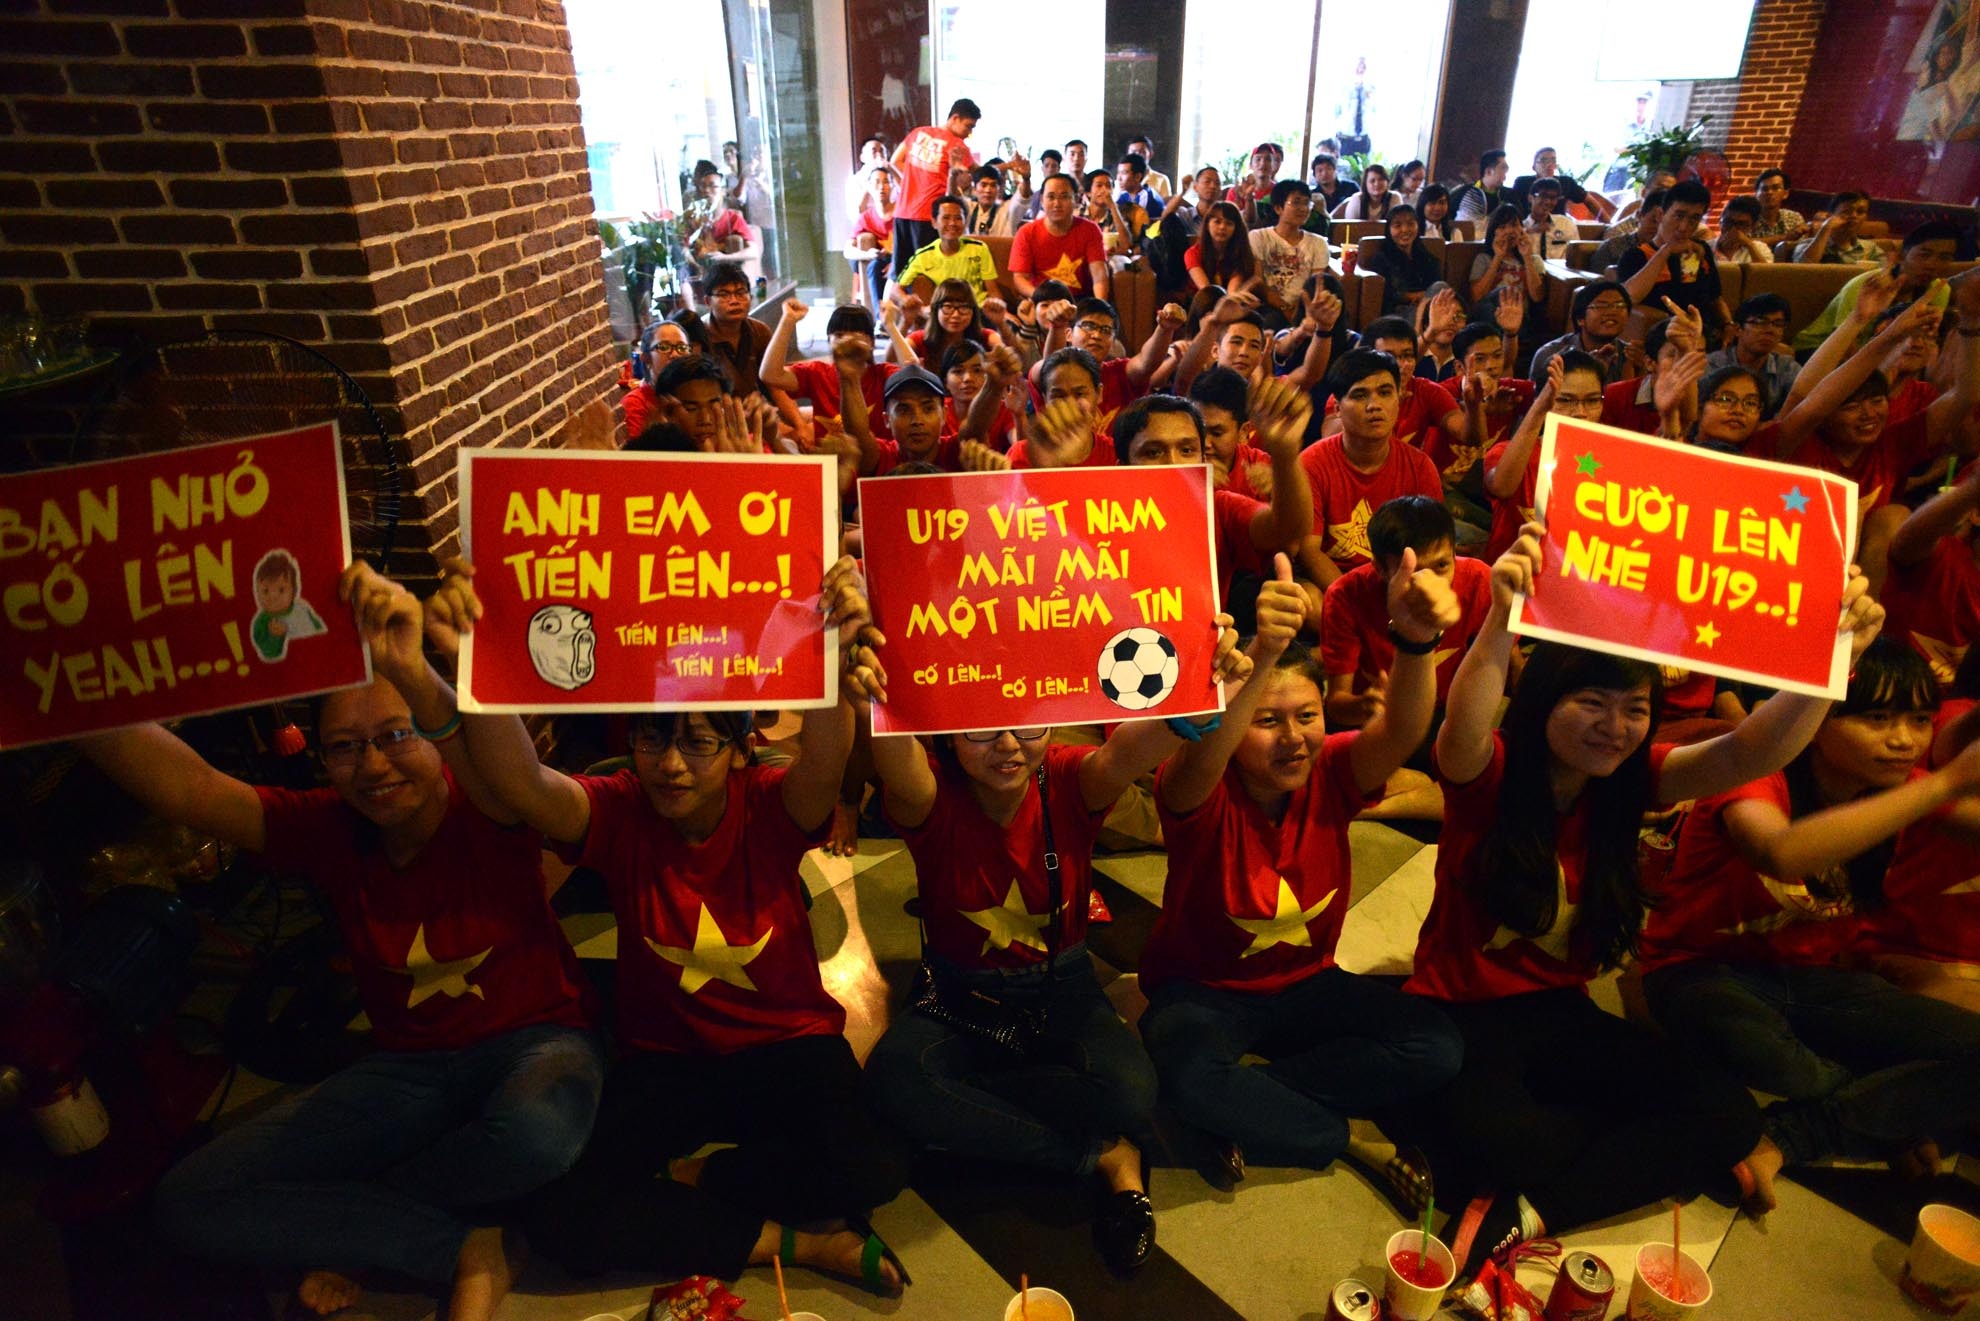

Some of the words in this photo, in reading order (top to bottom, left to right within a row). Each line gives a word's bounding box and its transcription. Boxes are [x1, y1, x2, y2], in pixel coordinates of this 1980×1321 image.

[0, 484, 118, 560] BẠN
[152, 450, 269, 533] NHỎ
[503, 488, 600, 536] ANH
[626, 489, 711, 537] EM
[739, 490, 791, 537] ƠI
[907, 508, 970, 544] U19
[988, 498, 1069, 542] VIỆT
[1086, 497, 1167, 535] NAM
[1575, 481, 1689, 541] CƯỜI
[1713, 508, 1802, 565] LÊN
[2, 549, 90, 632] CỐ
[124, 539, 235, 622] LÊN
[503, 539, 611, 600] TIẾN
[640, 546, 793, 603] LÊN...!
[958, 546, 1035, 589] MÃI
[1055, 541, 1129, 583] MÃI
[1561, 530, 1651, 592] NHÉ
[1677, 554, 1803, 626] U19..!
[615, 621, 658, 646] TIẾN
[666, 622, 728, 647] LÊN...!
[906, 596, 1000, 639] MỘT
[1017, 585, 1113, 632] NIỀM
[1131, 587, 1183, 625] TIN
[23, 621, 250, 714] YEAH...!
[671, 652, 714, 677] TIẾN
[723, 652, 783, 679] LÊN...!
[913, 663, 939, 685] CỐ
[948, 664, 1002, 685] LÊN...!
[1002, 676, 1027, 698] CỐ
[1036, 677, 1089, 698] LÊN...!
